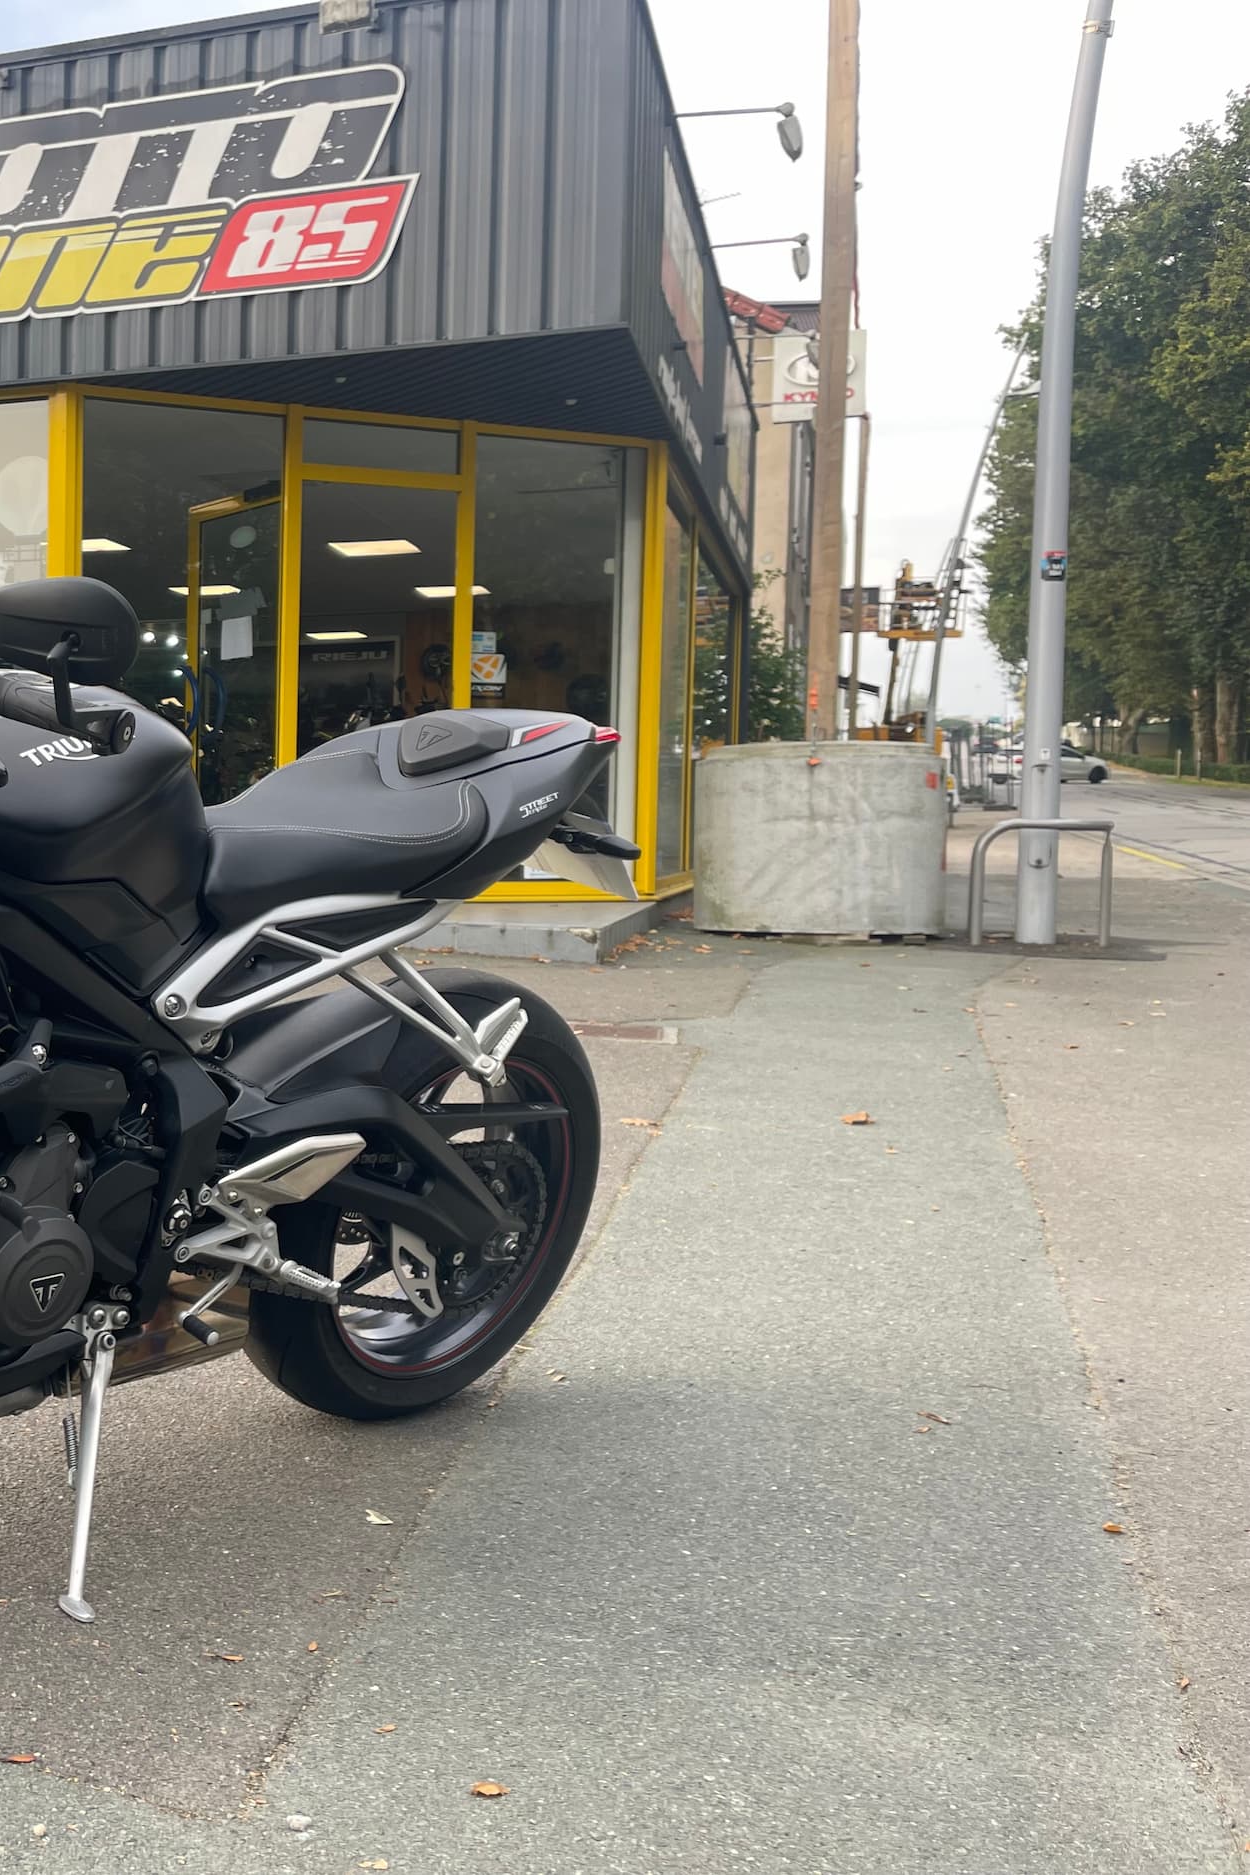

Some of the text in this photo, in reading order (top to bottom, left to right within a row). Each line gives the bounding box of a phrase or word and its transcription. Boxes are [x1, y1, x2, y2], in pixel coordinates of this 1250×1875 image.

[227, 195, 390, 279] 85
[311, 650, 388, 662] RIEJU
[519, 791, 559, 819] STREET
